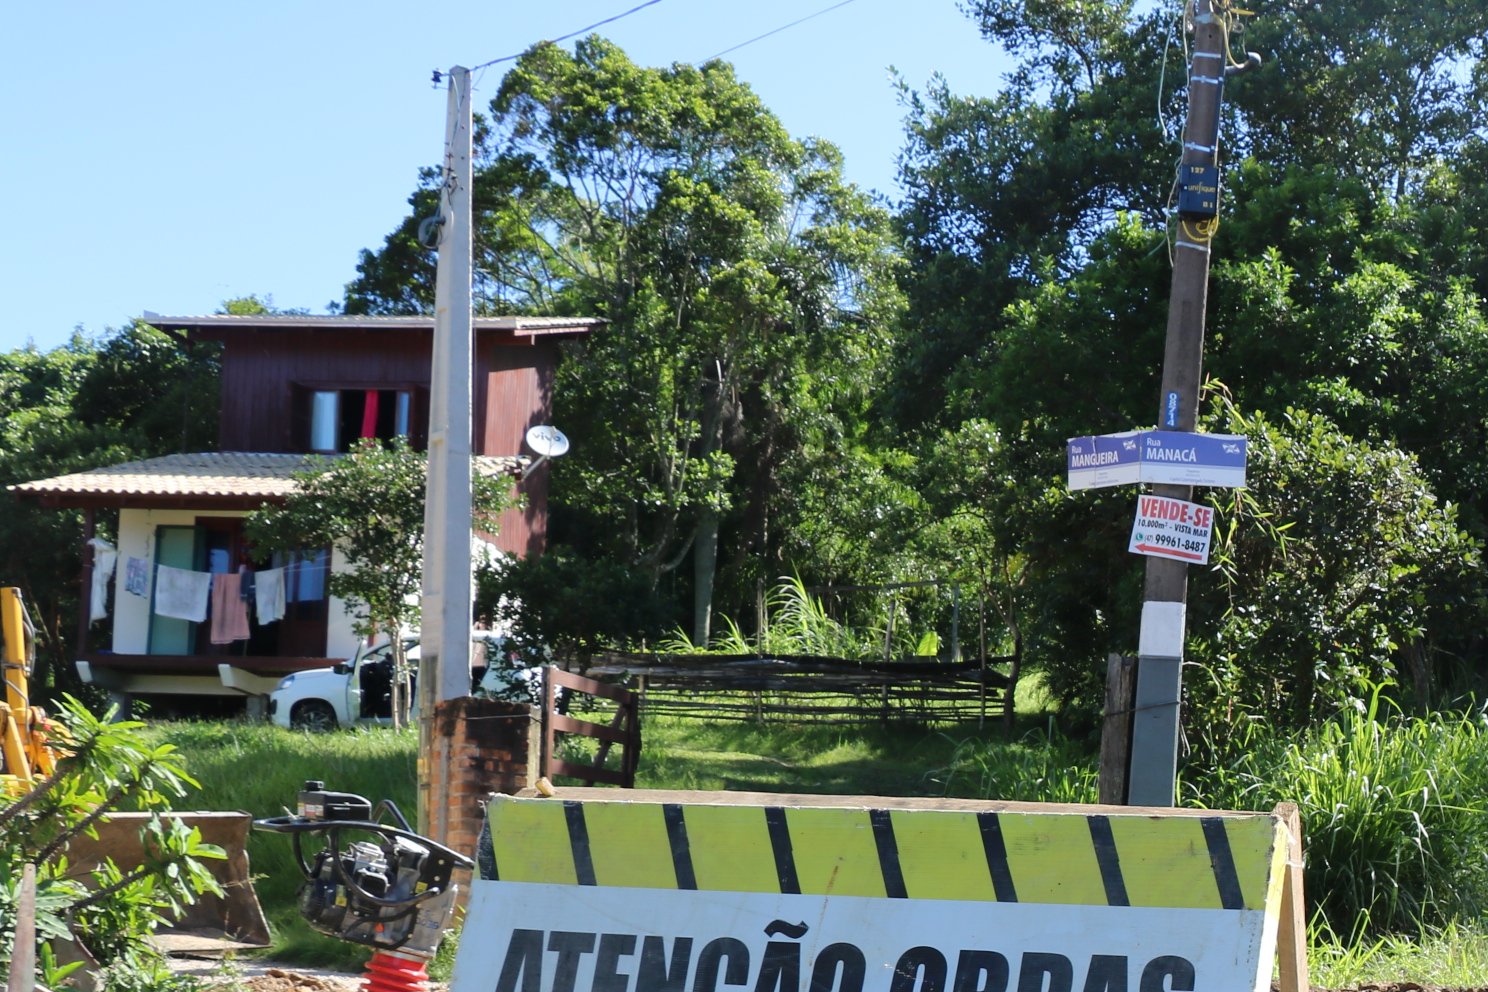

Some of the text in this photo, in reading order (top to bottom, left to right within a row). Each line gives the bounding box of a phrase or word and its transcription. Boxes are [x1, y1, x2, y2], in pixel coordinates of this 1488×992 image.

[532, 431, 561, 441] vivo
[1146, 437, 1161, 447] Rua
[1071, 445, 1082, 454] Rua
[1146, 447, 1197, 462] MANACÁ
[1071, 450, 1119, 468] MANGUEIRA
[1141, 498, 1211, 528] VENDE-SE
[1174, 523, 1192, 535] VISTA
[1192, 528, 1209, 538] MAR
[1155, 533, 1206, 552] 99961-8487
